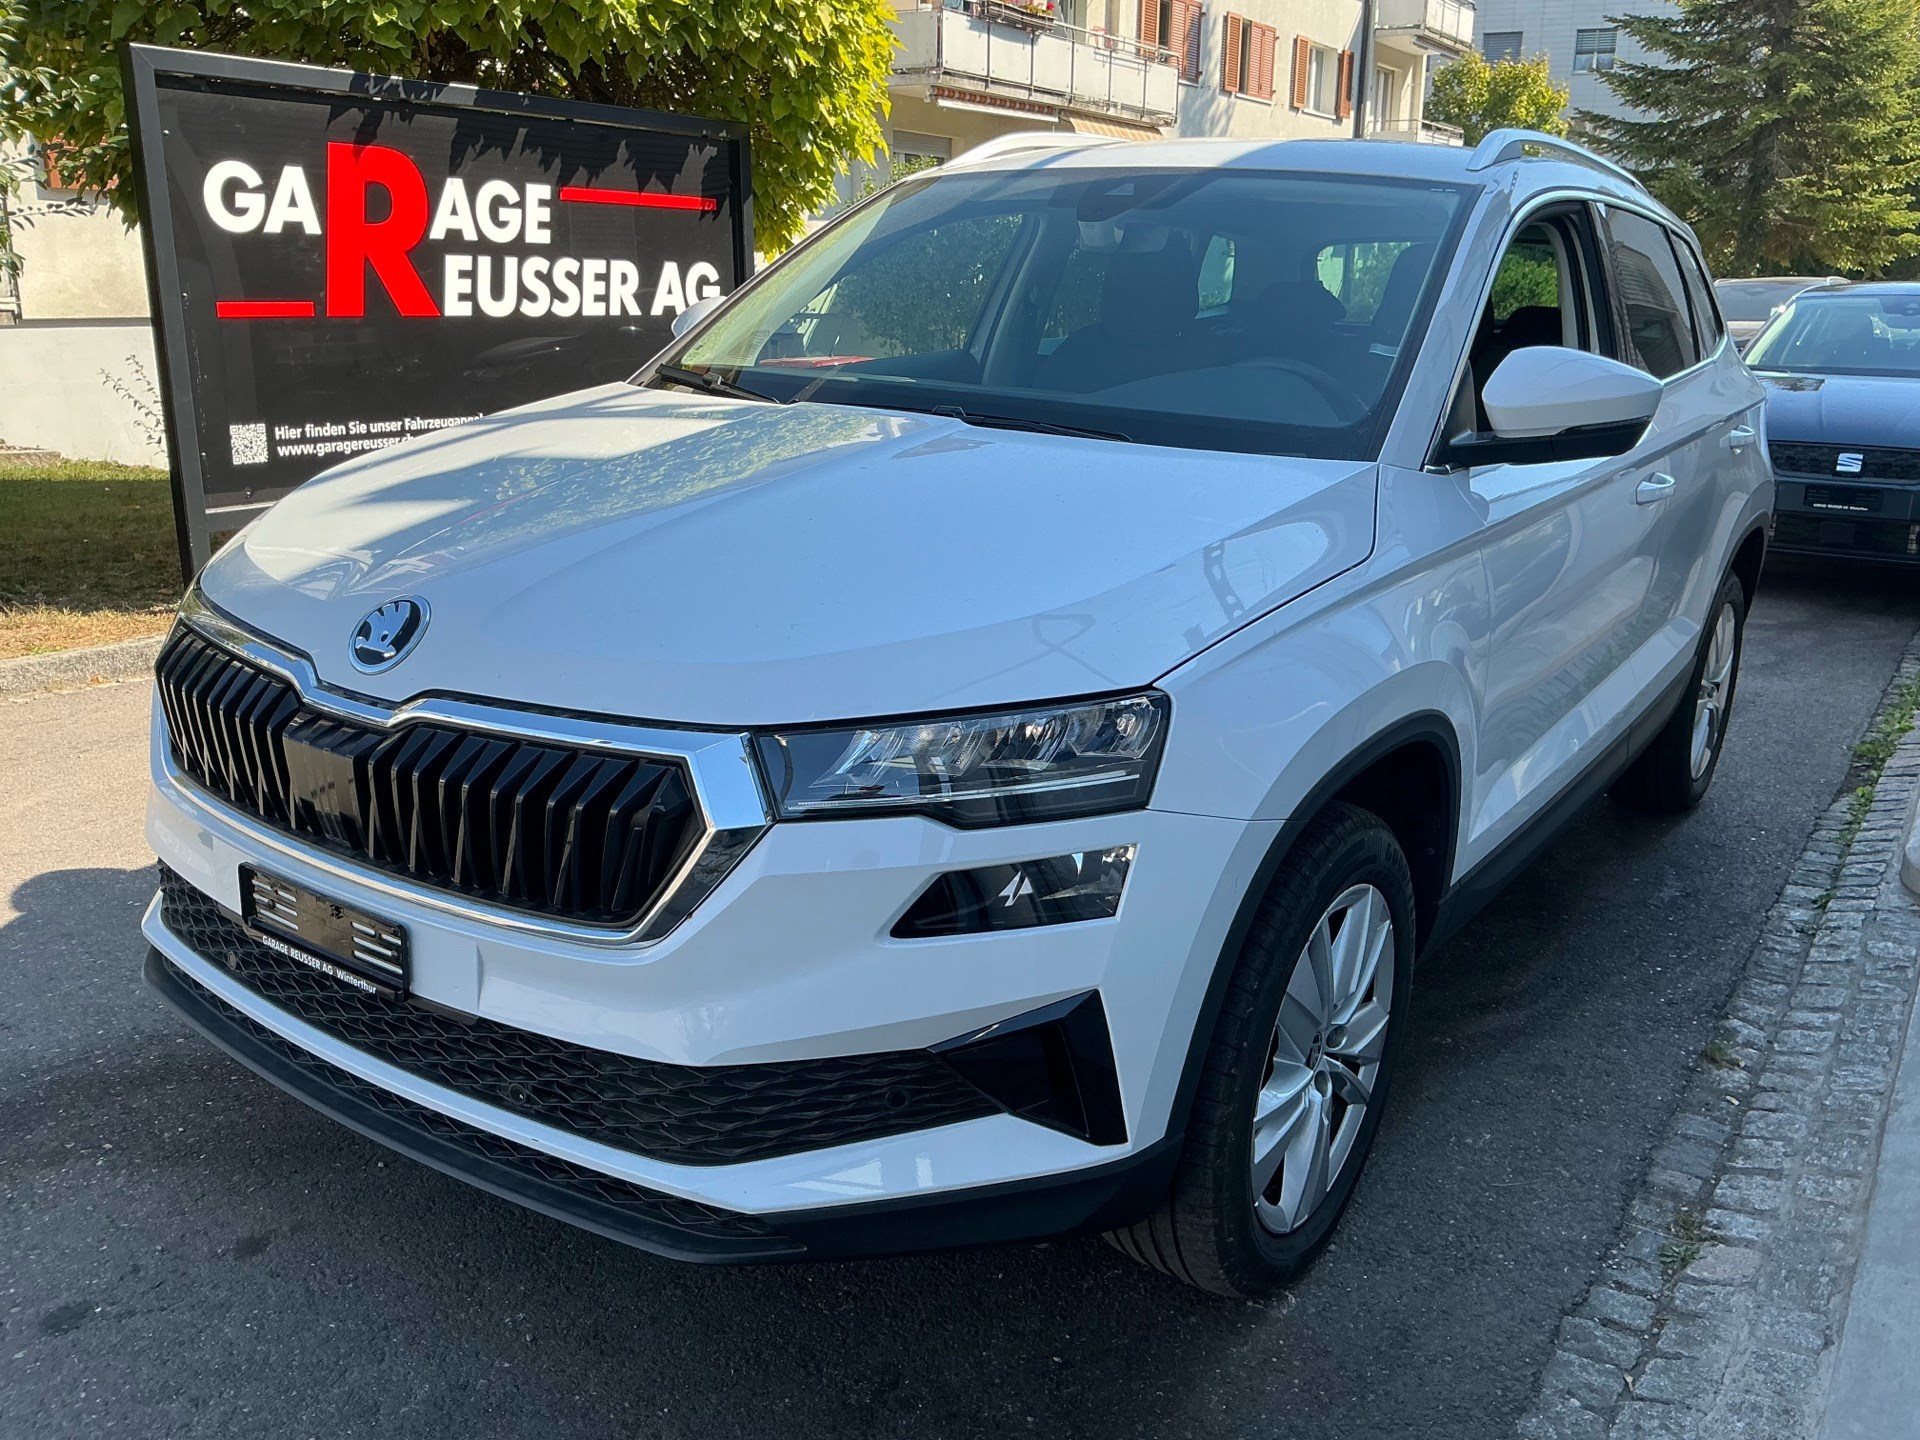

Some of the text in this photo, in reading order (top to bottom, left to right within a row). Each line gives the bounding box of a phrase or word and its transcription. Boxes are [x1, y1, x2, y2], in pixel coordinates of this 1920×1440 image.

[203, 141, 552, 318] GARAGE
[650, 261, 721, 316] AG
[274, 426, 302, 441] Hier
[304, 423, 346, 438] finden
[349, 420, 368, 436] Sie
[370, 419, 402, 433] unser
[262, 935, 378, 994] GARAGE REUSSER AG Winterthur
